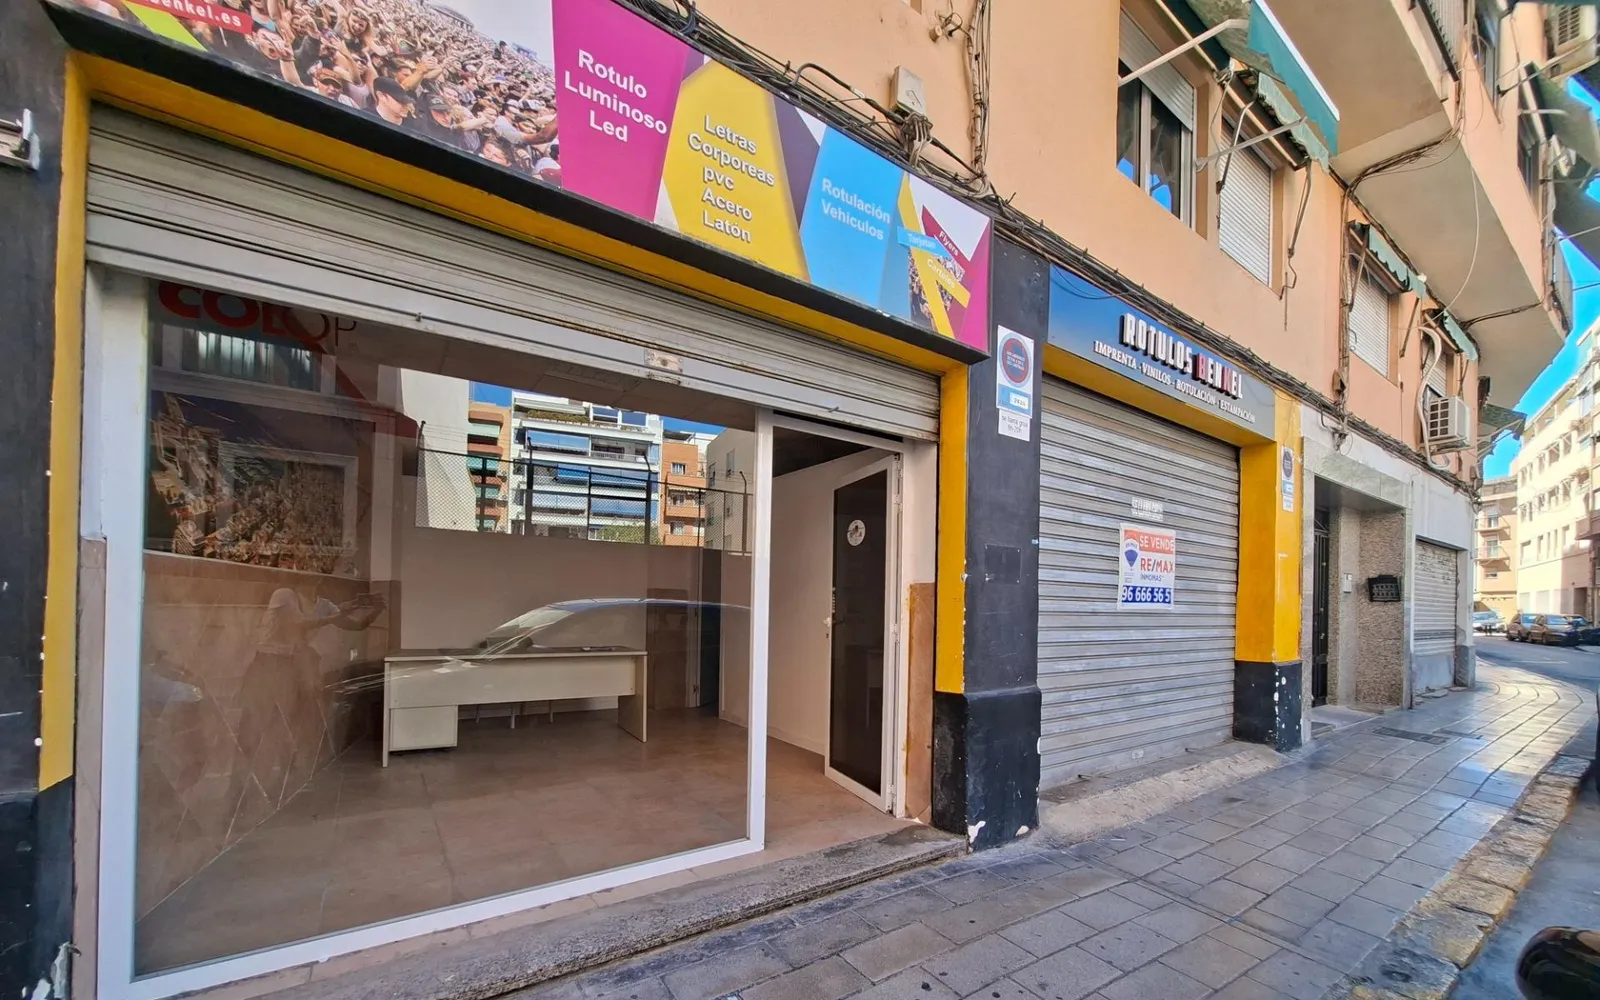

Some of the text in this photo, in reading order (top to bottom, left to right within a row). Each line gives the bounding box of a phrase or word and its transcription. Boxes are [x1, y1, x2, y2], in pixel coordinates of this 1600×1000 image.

[578, 48, 648, 99] Rotulo
[564, 70, 668, 135] Luminoso
[589, 109, 628, 142] Led
[704, 114, 757, 155] Letras
[688, 132, 775, 187] Corporeas
[703, 166, 734, 190] pvc
[701, 187, 753, 221] Acero
[822, 177, 891, 224] Rotulación
[703, 209, 751, 243] Latón
[939, 230, 959, 256] Flyers
[1093, 340, 1137, 370] IMPRENTA
[1141, 362, 1172, 386] VINILOS
[1175, 379, 1216, 406] ROTULACIÓN
[1120, 312, 1243, 400] ROTULOS BENKEL
[1139, 534, 1175, 552] SE VENDE
[1140, 557, 1174, 574] RE/MAX
[1122, 586, 1134, 602] 96
[1135, 587, 1152, 603] 666
[1153, 588, 1164, 603] 56
